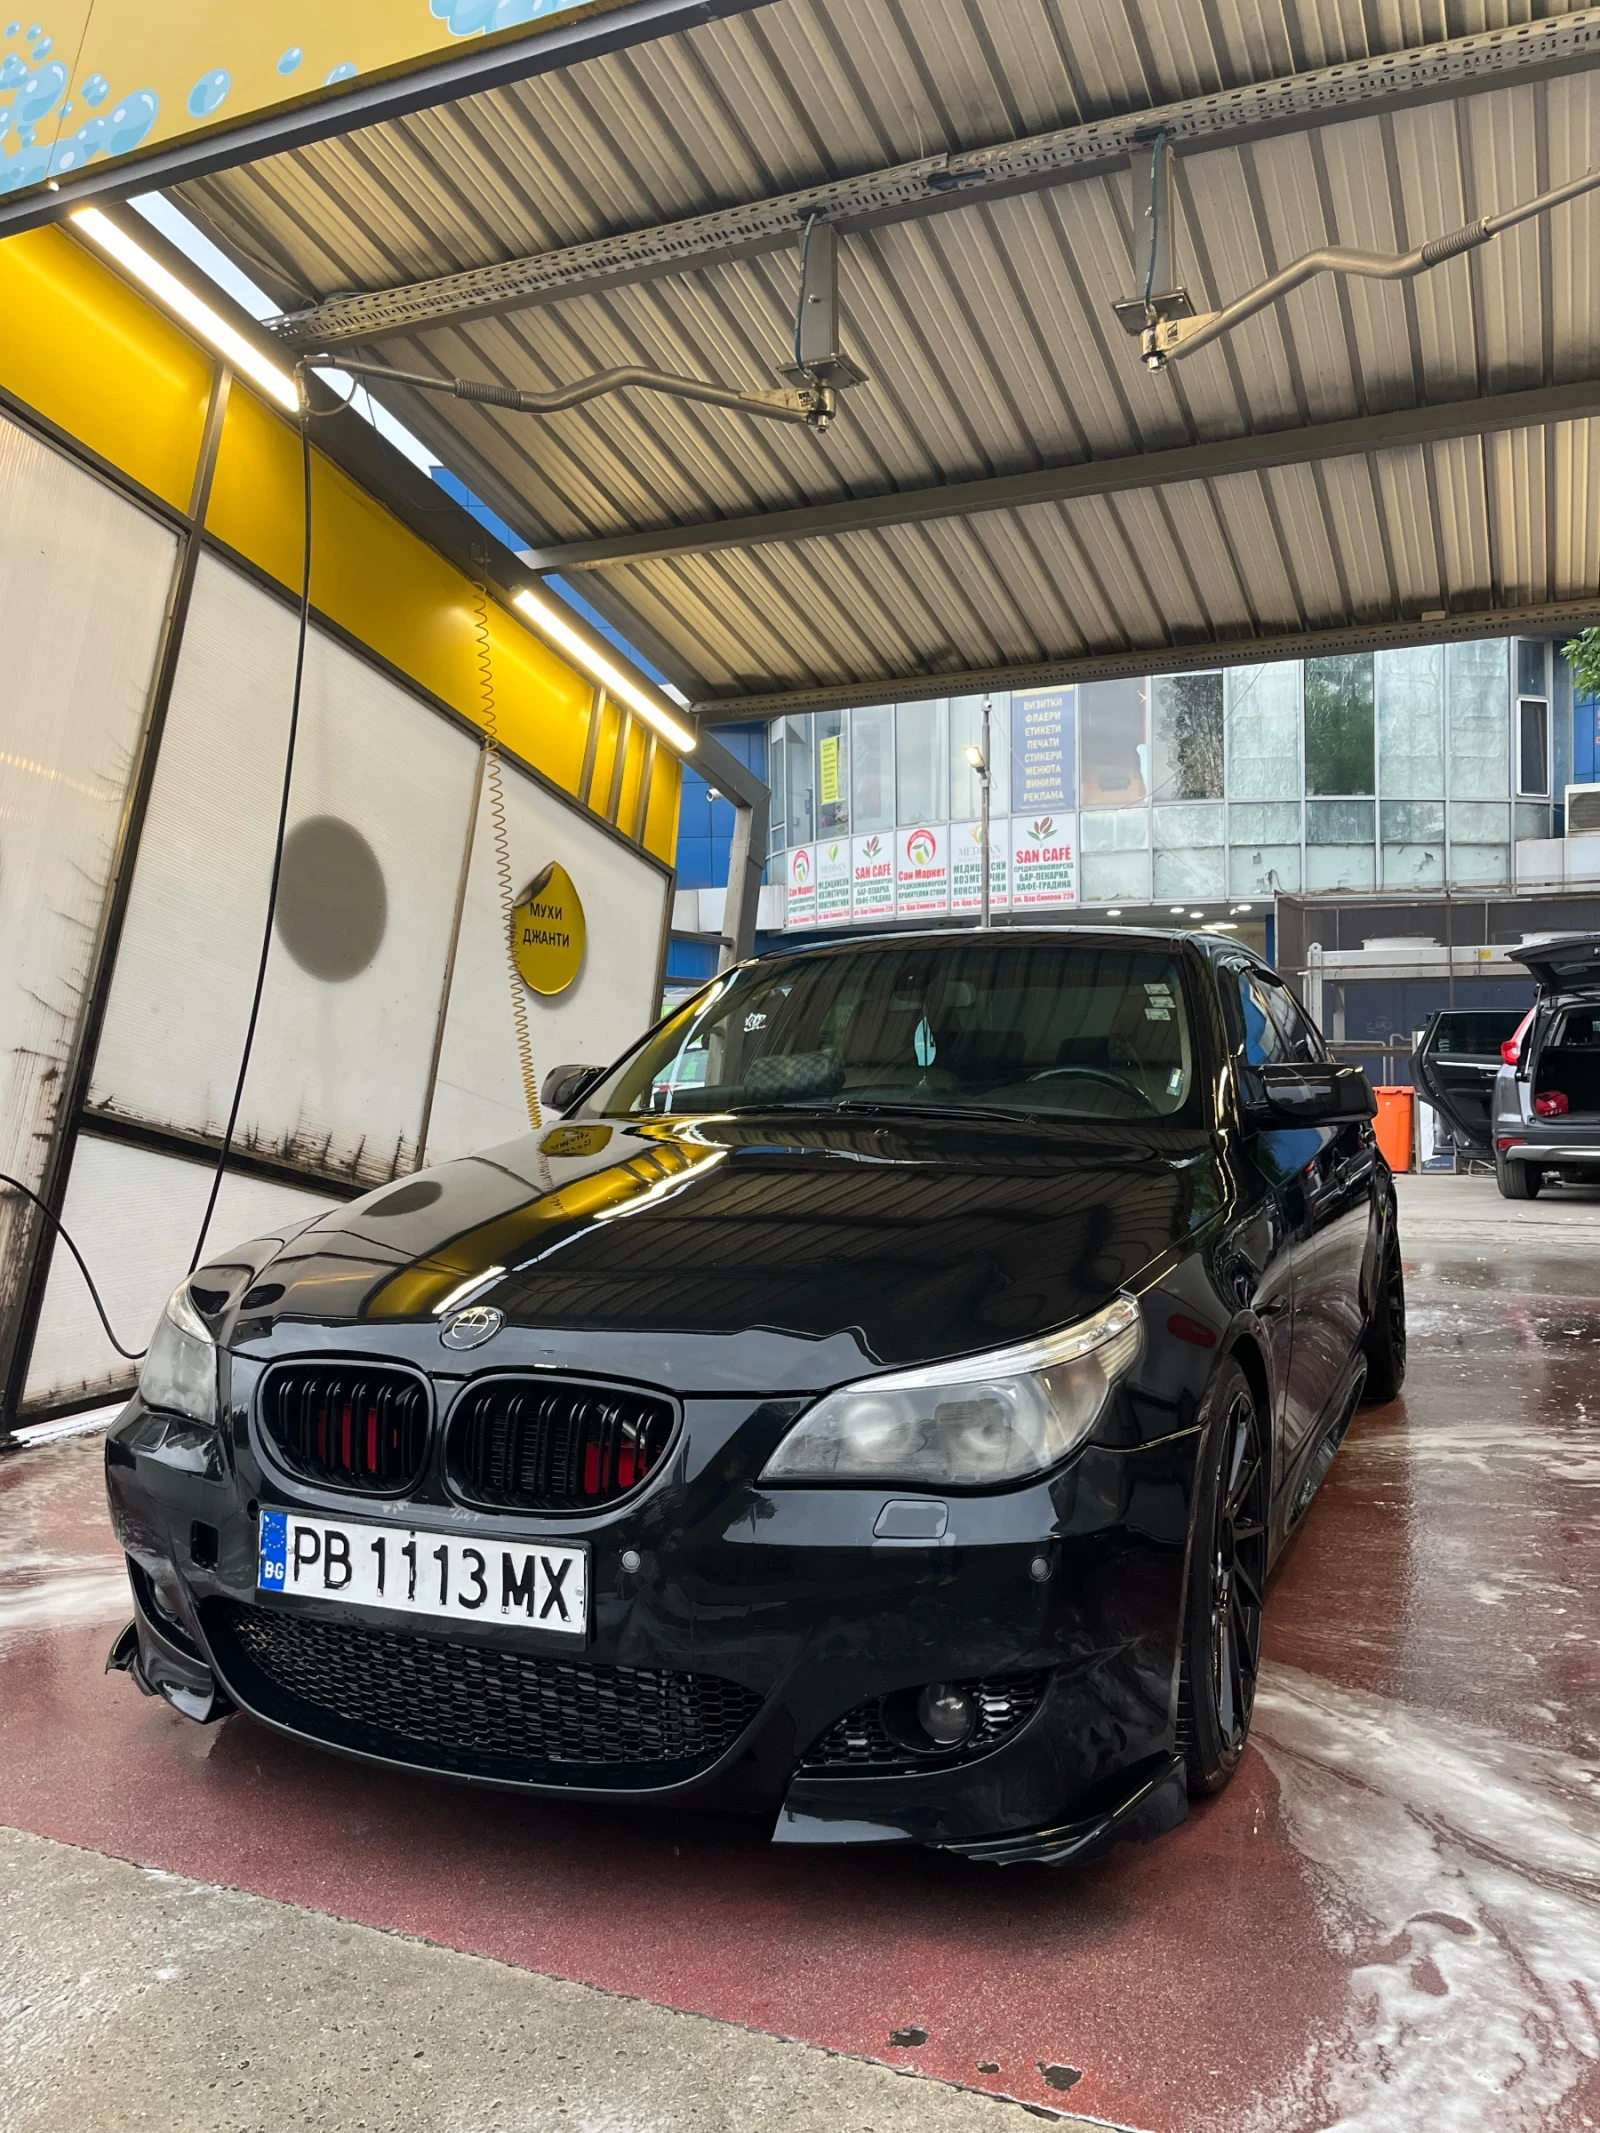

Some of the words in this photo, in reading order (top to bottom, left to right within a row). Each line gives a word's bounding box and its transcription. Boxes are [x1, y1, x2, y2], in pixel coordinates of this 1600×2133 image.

[1024, 698, 1062, 710] ВИЗИТКИ
[1025, 711, 1061, 723] ФЛАЕРИ
[1025, 724, 1061, 736] ЕТИКЕТИ
[1027, 738, 1059, 750] ПЕЧАТИ
[1024, 751, 1062, 763] СТИКЕРИ
[1025, 764, 1061, 776] МЕНЮТА
[1026, 777, 1061, 789] ВИНИЛИ
[1024, 790, 1064, 802] РЕКЛАМА
[1016, 850, 1039, 864] SAN
[1043, 845, 1071, 862] CAFÉ
[855, 866, 870, 880] SAN
[872, 861, 891, 878] CAFÉ
[954, 861, 1006, 874] МЕДИЦСКИ
[898, 870, 913, 881] Сан
[915, 868, 946, 880] Маркет
[954, 872, 1006, 884] КОЗМЕЧНИ
[1017, 880, 1071, 891] КАФЕ-ГРАДИНА
[530, 902, 563, 921] МУХИ
[522, 928, 570, 948] ДЖАНТИ
[264, 1562, 284, 1580] BG
[293, 1526, 352, 1590] PB
[370, 1536, 488, 1610] 1113
[501, 1551, 573, 1623] MX
